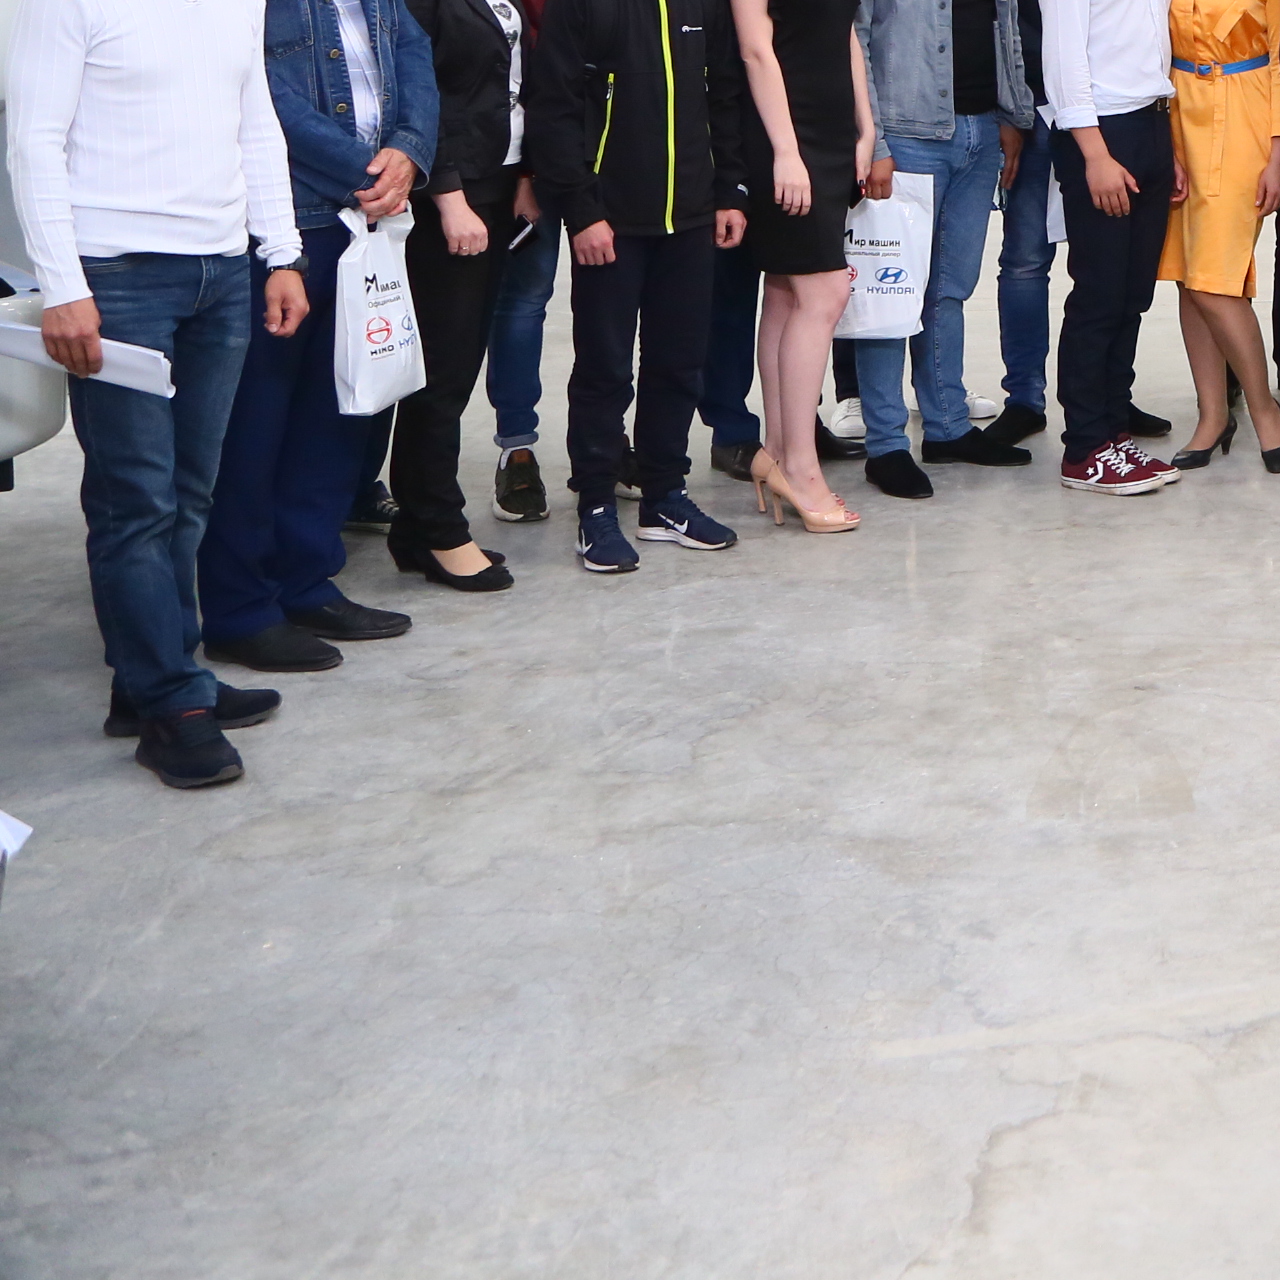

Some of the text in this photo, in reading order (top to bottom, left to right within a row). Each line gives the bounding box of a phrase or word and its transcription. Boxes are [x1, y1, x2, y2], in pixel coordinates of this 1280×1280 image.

[868, 239, 901, 248] машин
[866, 285, 915, 295] HYUNDAI
[370, 344, 395, 357] HINO
